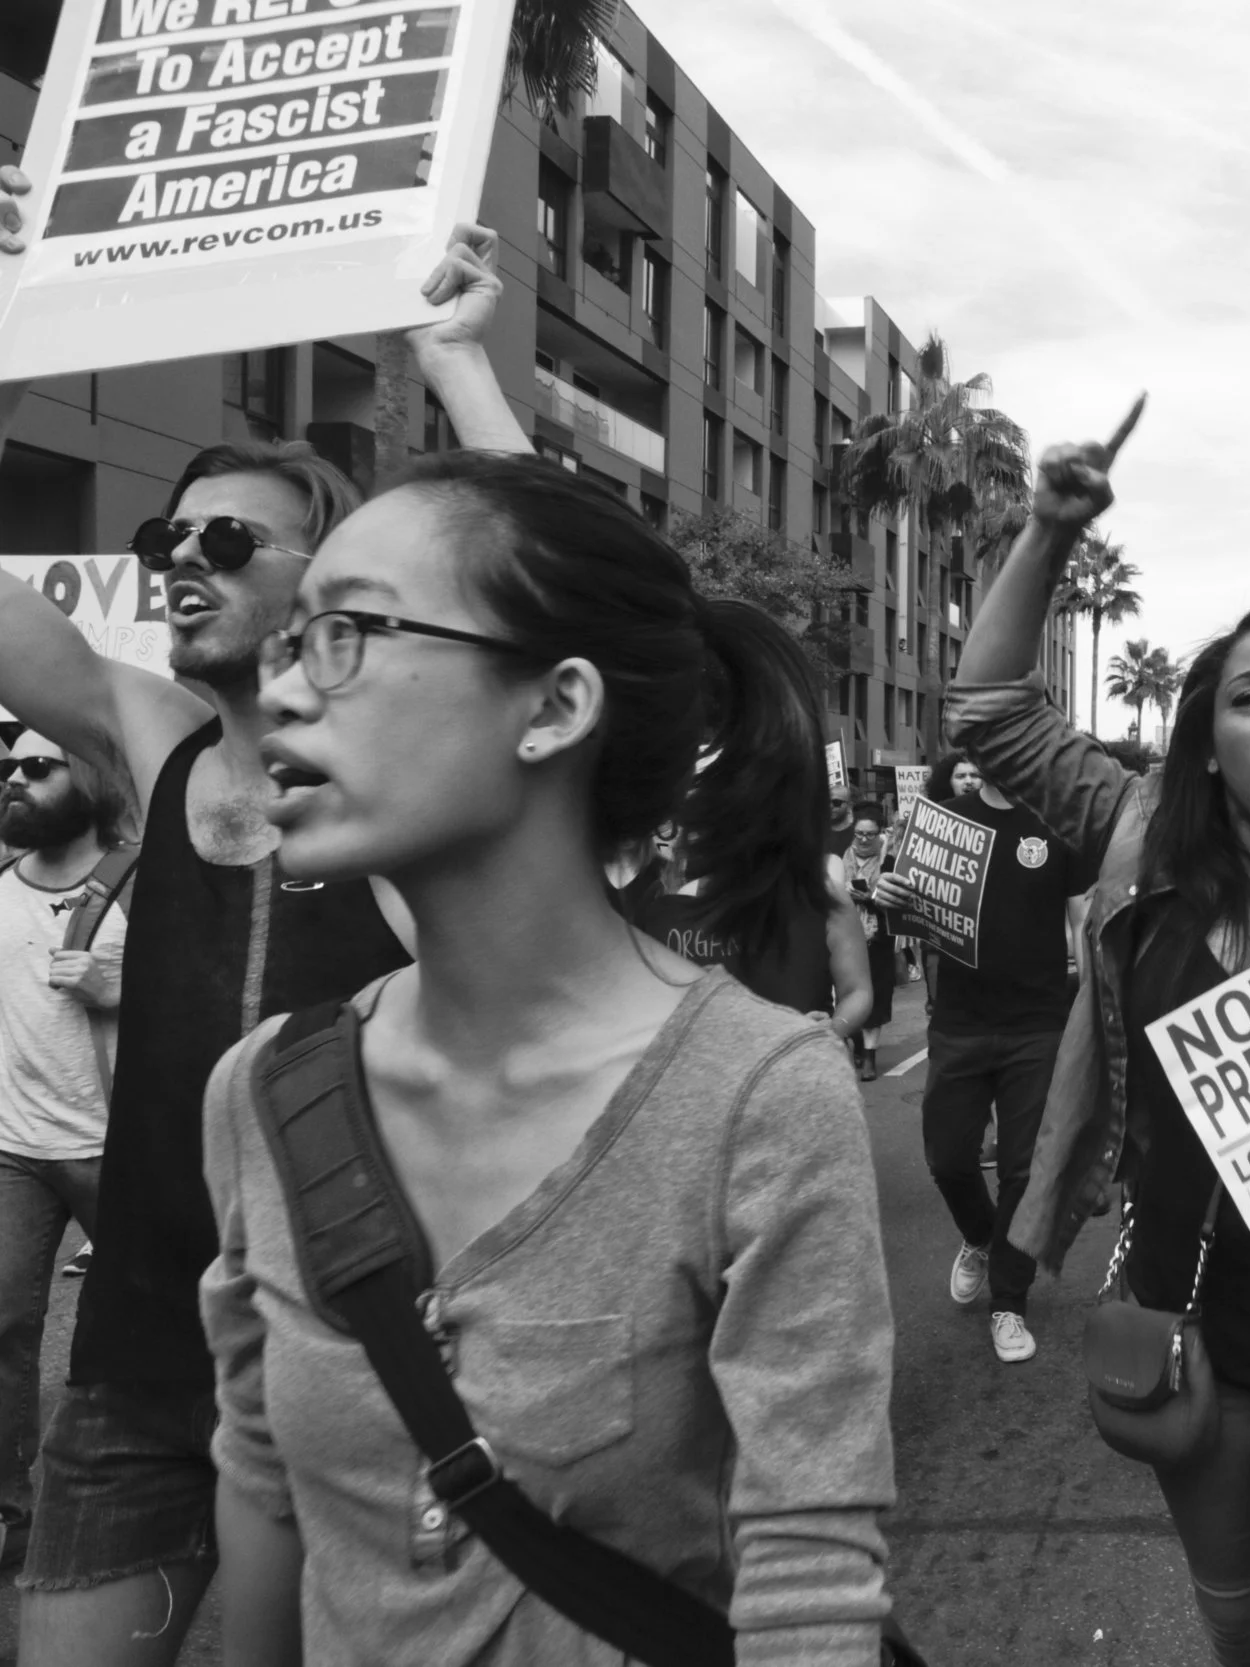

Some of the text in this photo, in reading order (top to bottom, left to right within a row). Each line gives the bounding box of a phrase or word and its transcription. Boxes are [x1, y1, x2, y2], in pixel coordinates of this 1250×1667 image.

[136, 15, 408, 95] To Accept
[124, 79, 386, 160] a Fascist
[117, 153, 359, 224] America
[73, 206, 383, 268] www.revcom.us
[26, 558, 168, 622] OVE
[898, 771, 929, 781] HATE
[906, 834, 979, 884] FAMILIES
[915, 802, 985, 856] WORKING
[908, 866, 962, 908] STAND
